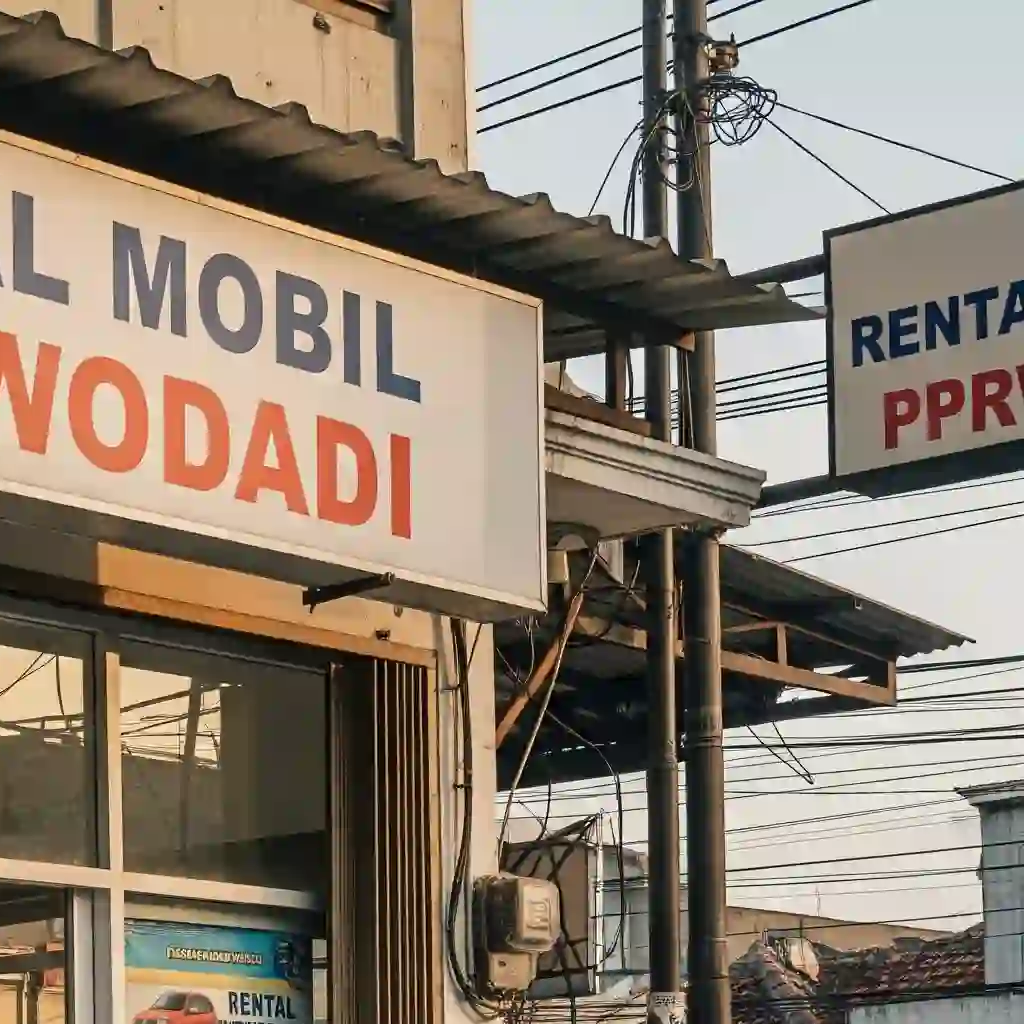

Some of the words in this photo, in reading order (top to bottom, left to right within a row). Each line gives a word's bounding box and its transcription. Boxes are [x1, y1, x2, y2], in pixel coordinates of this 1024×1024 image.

[112, 220, 421, 404] MOBIL
[883, 364, 1024, 450] PPR
[228, 991, 296, 1020] RENTAL
